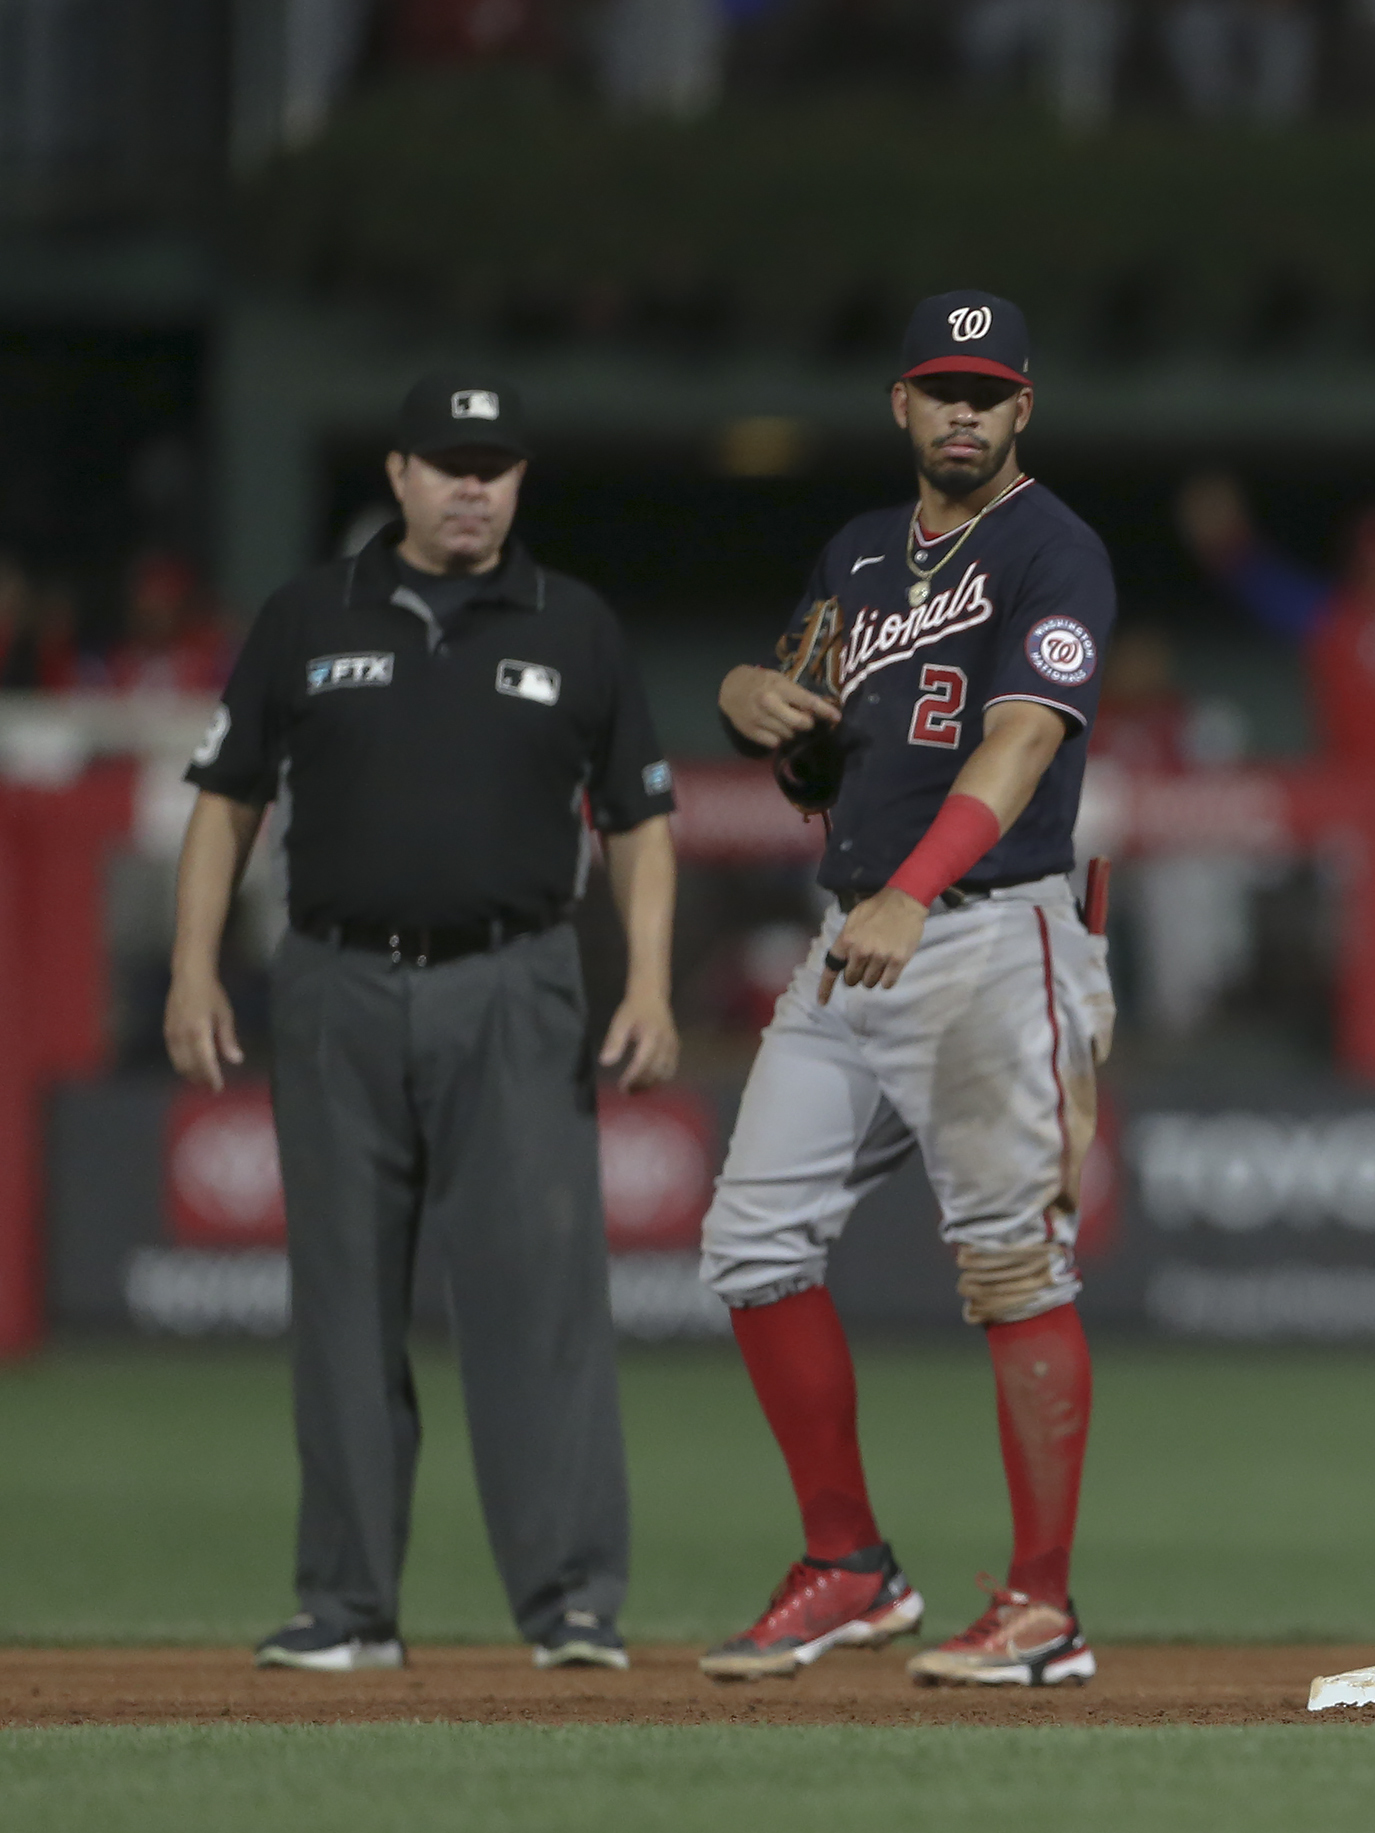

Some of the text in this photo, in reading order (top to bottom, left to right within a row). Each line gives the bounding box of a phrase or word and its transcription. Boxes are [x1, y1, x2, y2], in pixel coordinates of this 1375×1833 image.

[948, 306, 992, 342] W
[1048, 639, 1078, 664] W
[331, 656, 393, 685] FTX
[907, 663, 968, 750] 2
